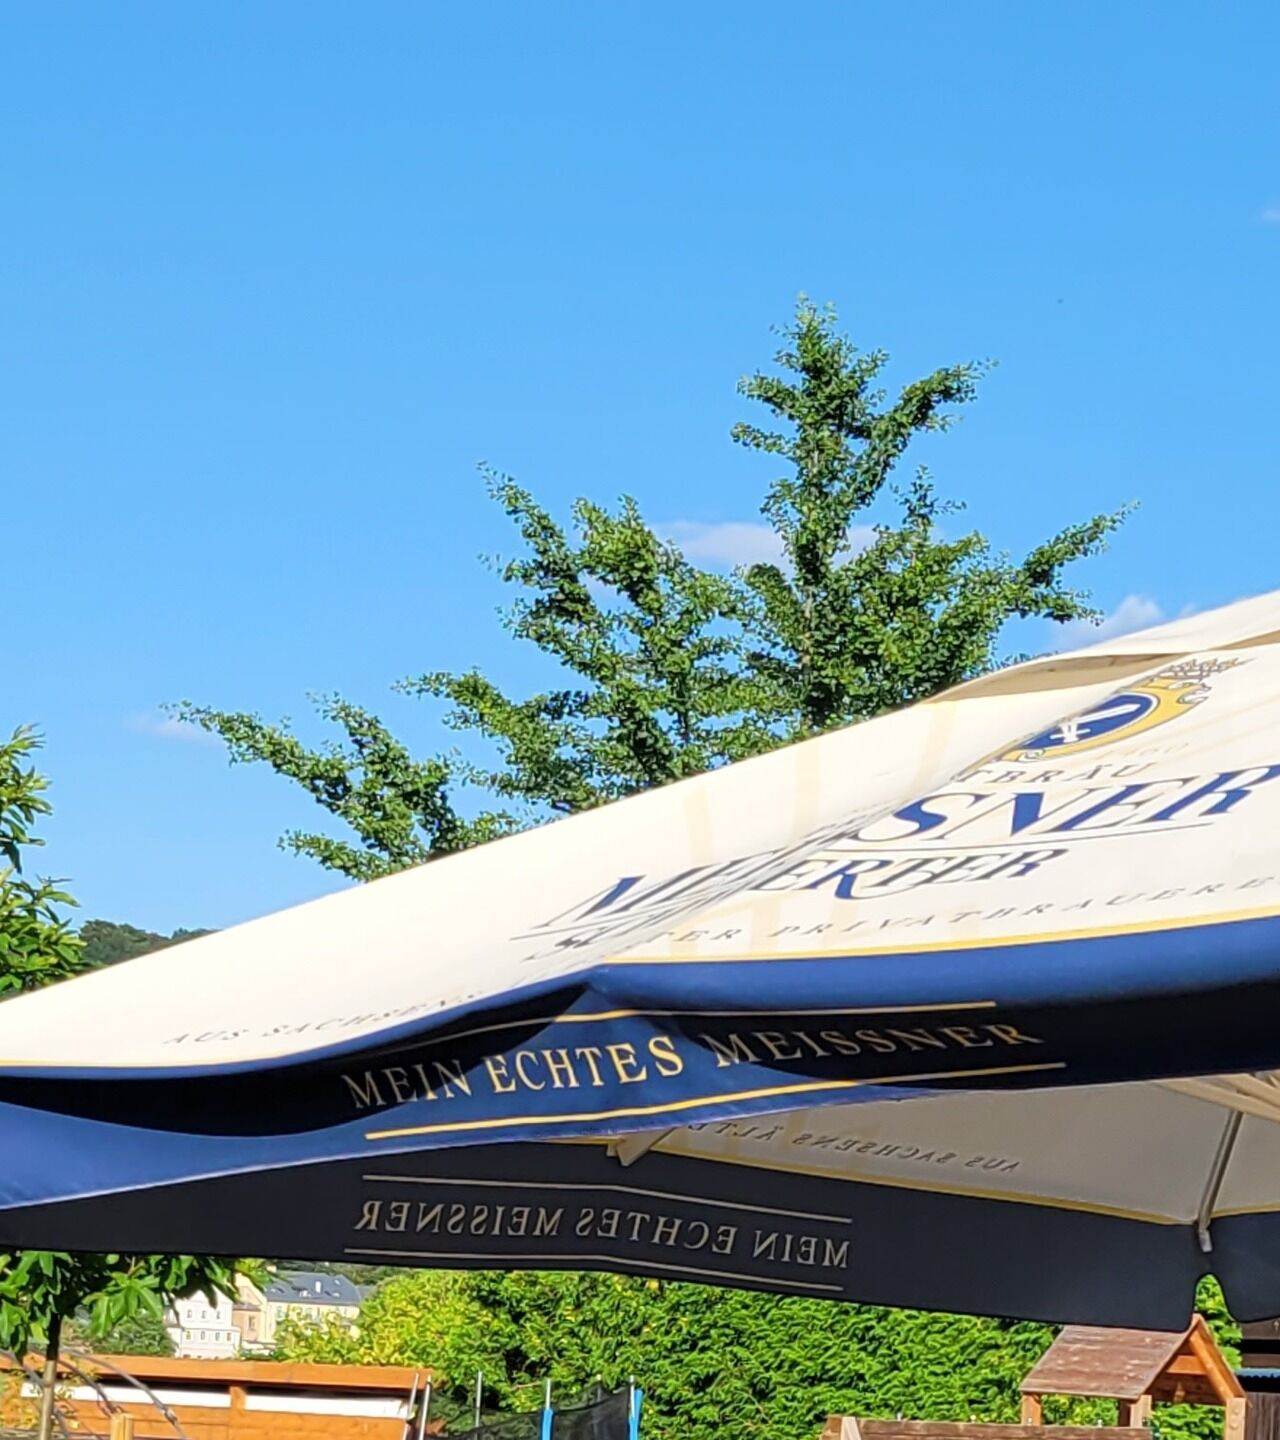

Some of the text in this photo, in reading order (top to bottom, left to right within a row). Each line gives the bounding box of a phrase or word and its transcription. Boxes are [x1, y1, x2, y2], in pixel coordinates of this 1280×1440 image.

[339, 1023, 1046, 1110] MEIN ECHTES MEISSNER
